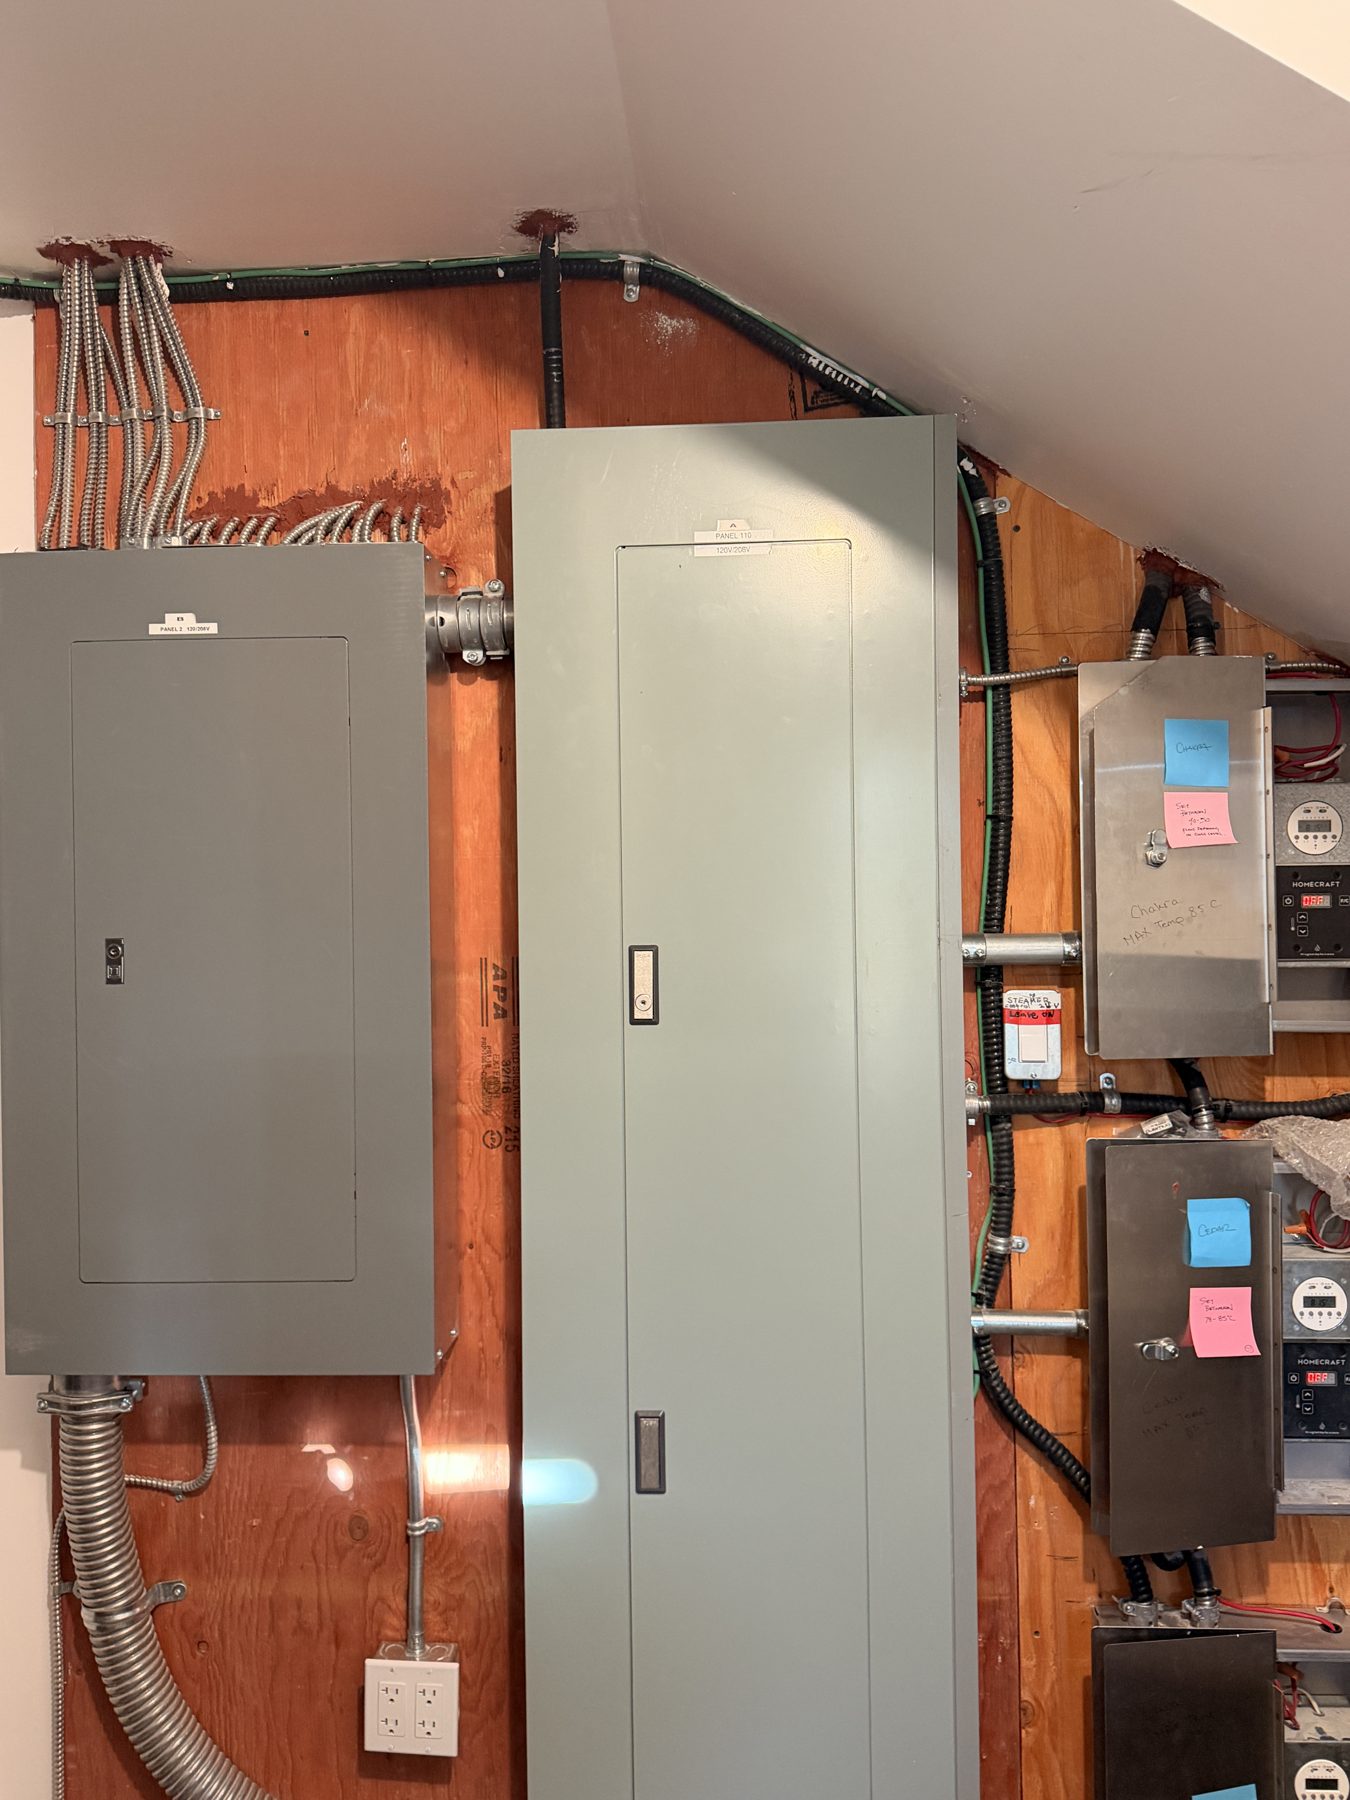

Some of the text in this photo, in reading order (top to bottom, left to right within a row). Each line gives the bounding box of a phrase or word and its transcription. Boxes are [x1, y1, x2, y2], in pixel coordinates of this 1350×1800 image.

[1130, 899, 1182, 919] Chakra
[1302, 895, 1324, 906] OFF
[1122, 927, 1152, 947] MAX
[1188, 904, 1205, 918] 85
[492, 962, 508, 1020] APA
[1007, 997, 1050, 1005] STEAMER
[501, 1059, 512, 1094] 32/16
[1307, 1372, 1328, 1384] OFF
